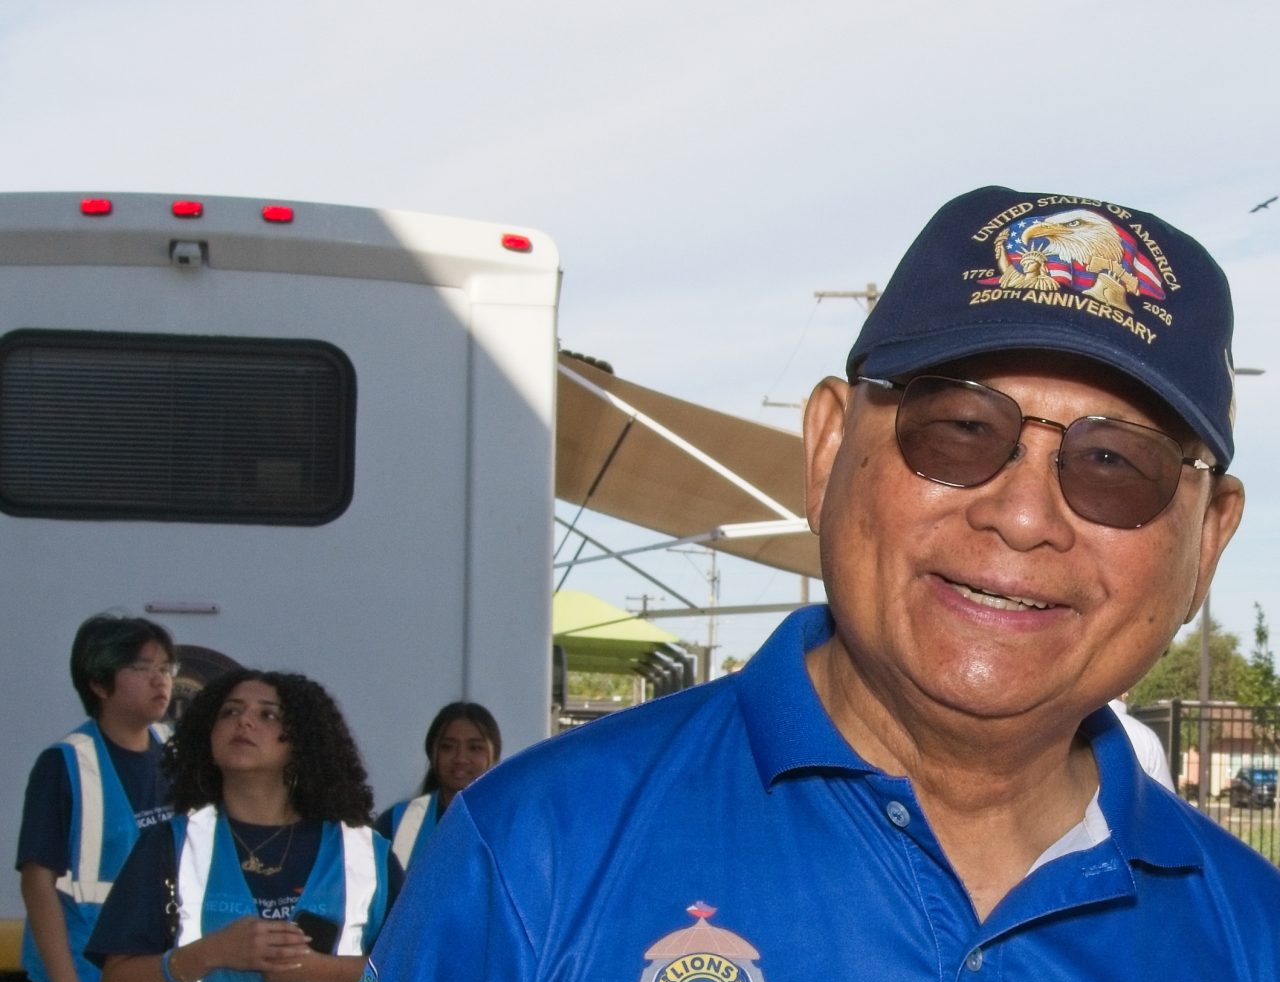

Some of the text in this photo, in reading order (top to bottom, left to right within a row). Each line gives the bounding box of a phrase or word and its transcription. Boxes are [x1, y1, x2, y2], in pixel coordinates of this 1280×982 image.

[971, 195, 1182, 292] UNITED STATES OF AMERICA
[962, 268, 995, 281] 1776
[969, 289, 1158, 345] 250TH ANNIVERSARY
[1143, 301, 1173, 327] 2026
[671, 956, 734, 979] LIONS
